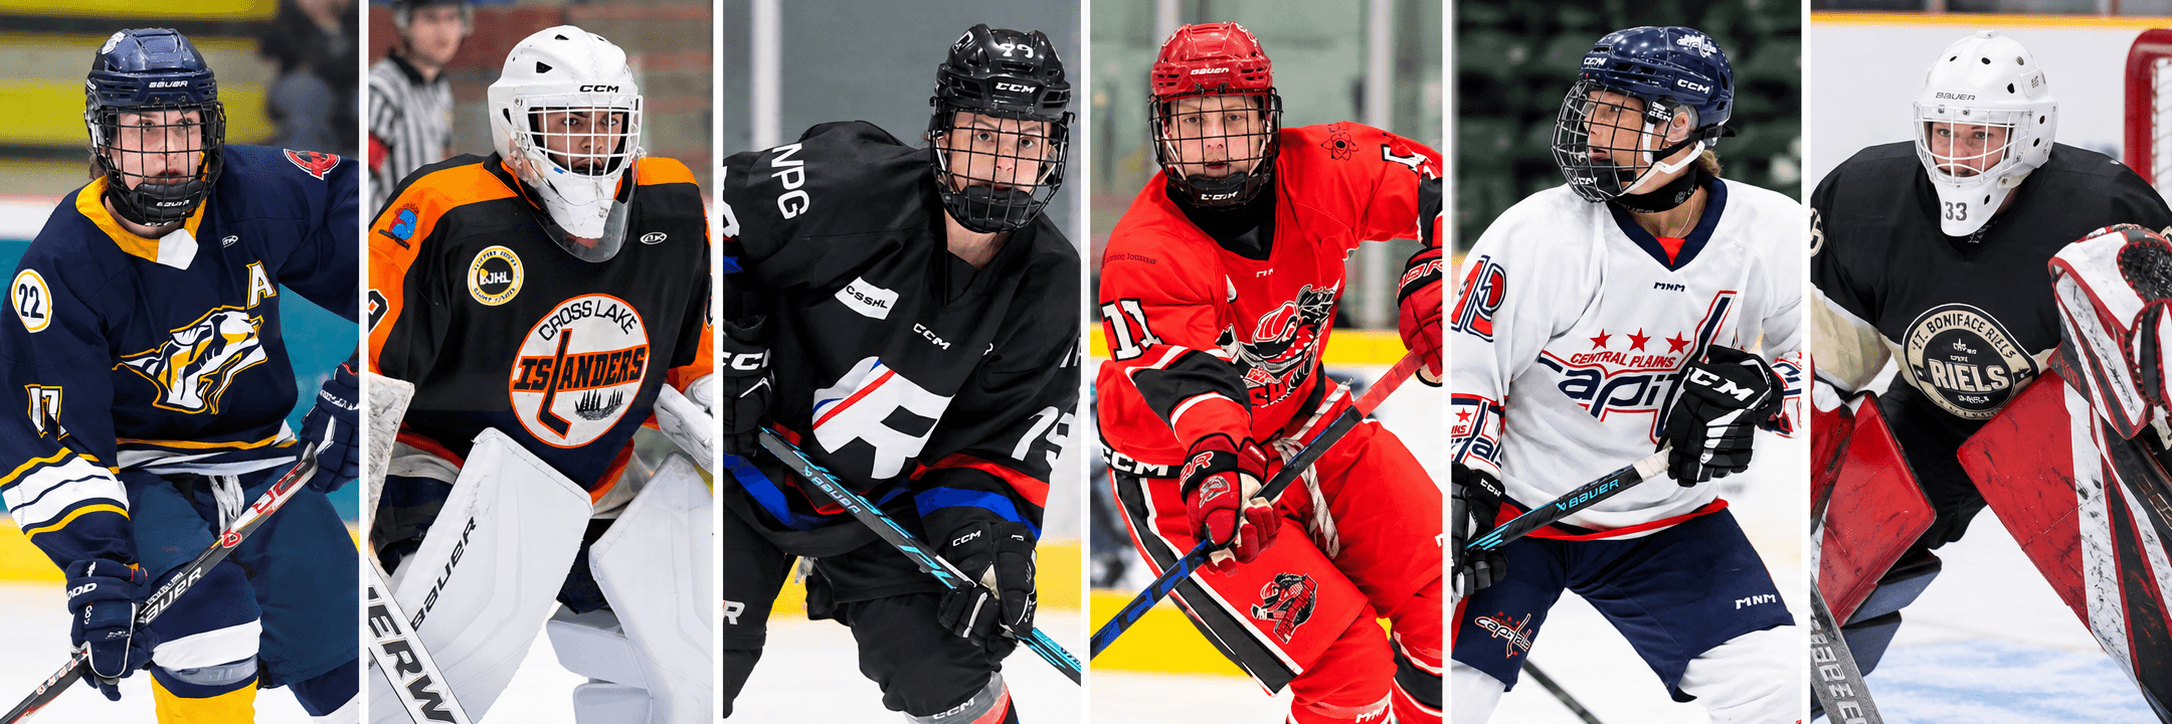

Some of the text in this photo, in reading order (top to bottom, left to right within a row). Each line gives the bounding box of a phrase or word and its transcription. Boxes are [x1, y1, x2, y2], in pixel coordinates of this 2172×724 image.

[1583, 57, 1608, 66] CCM
[579, 85, 619, 93] CCM
[995, 82, 1037, 94] CCM
[1676, 78, 1711, 95] CCM
[1935, 91, 1976, 101] BAUER
[1945, 201, 1967, 221] 33
[246, 260, 277, 309] A
[1653, 281, 1686, 292] MNM
[18, 283, 44, 319] 22
[845, 285, 888, 309] CSSHL
[538, 299, 637, 341] CROSS LAKE
[1099, 298, 1166, 362] 11
[1926, 313, 1986, 334] BONIFACE
[913, 322, 951, 350] CCM
[1570, 351, 1677, 368] CENTRAL PLAINS
[1927, 358, 2010, 392] RIELS
[24, 383, 70, 441] 17
[1100, 443, 1169, 477] CCM
[1568, 478, 1620, 509] BAUER
[952, 530, 982, 546] CCM
[410, 516, 477, 632] BAUER
[1735, 592, 1777, 609] MNM
[933, 697, 975, 719] CCM
